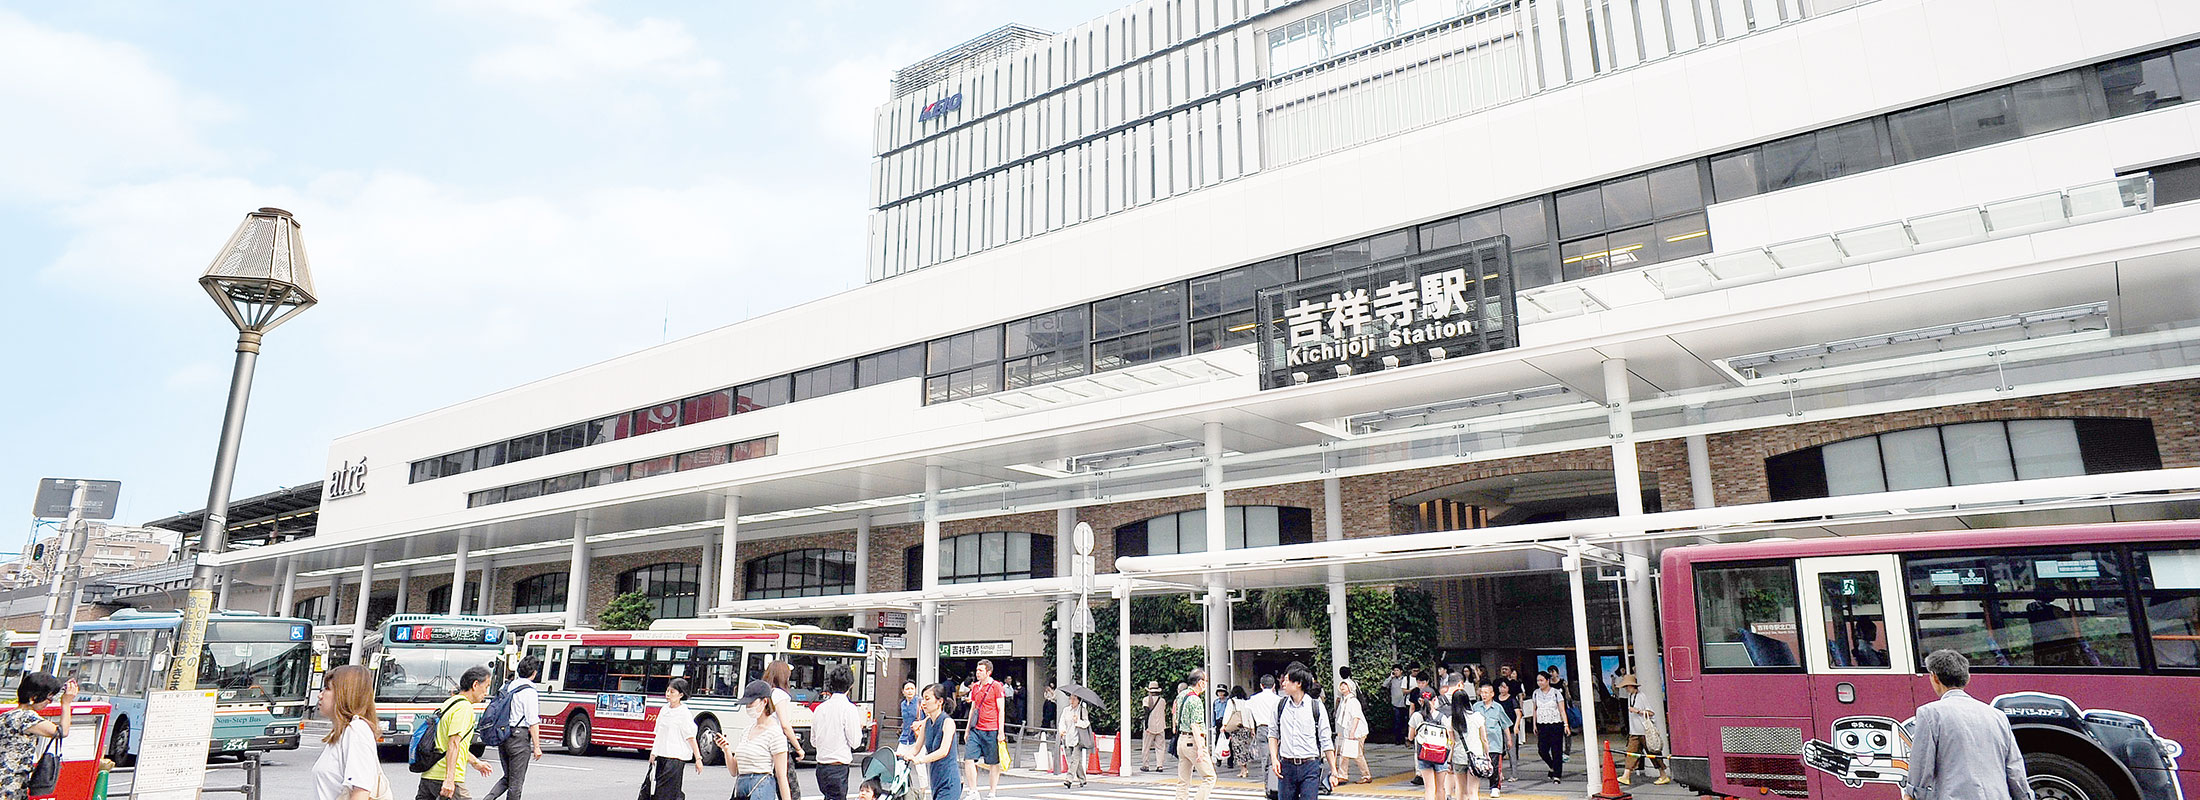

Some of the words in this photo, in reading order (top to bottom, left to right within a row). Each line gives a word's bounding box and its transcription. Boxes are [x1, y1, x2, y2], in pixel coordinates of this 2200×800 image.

[918, 92, 963, 123] KEIO
[1285, 267, 1469, 346] 吉祥寺駅
[1388, 319, 1472, 349] Station
[328, 456, 368, 497] atré
[187, 597, 209, 668] この周辺での
[939, 645, 949, 653] JR
[952, 645, 979, 655] 吉祥寺駅
[2003, 706, 2064, 717] ヨドバシカメラ
[226, 741, 249, 750] 25-64
